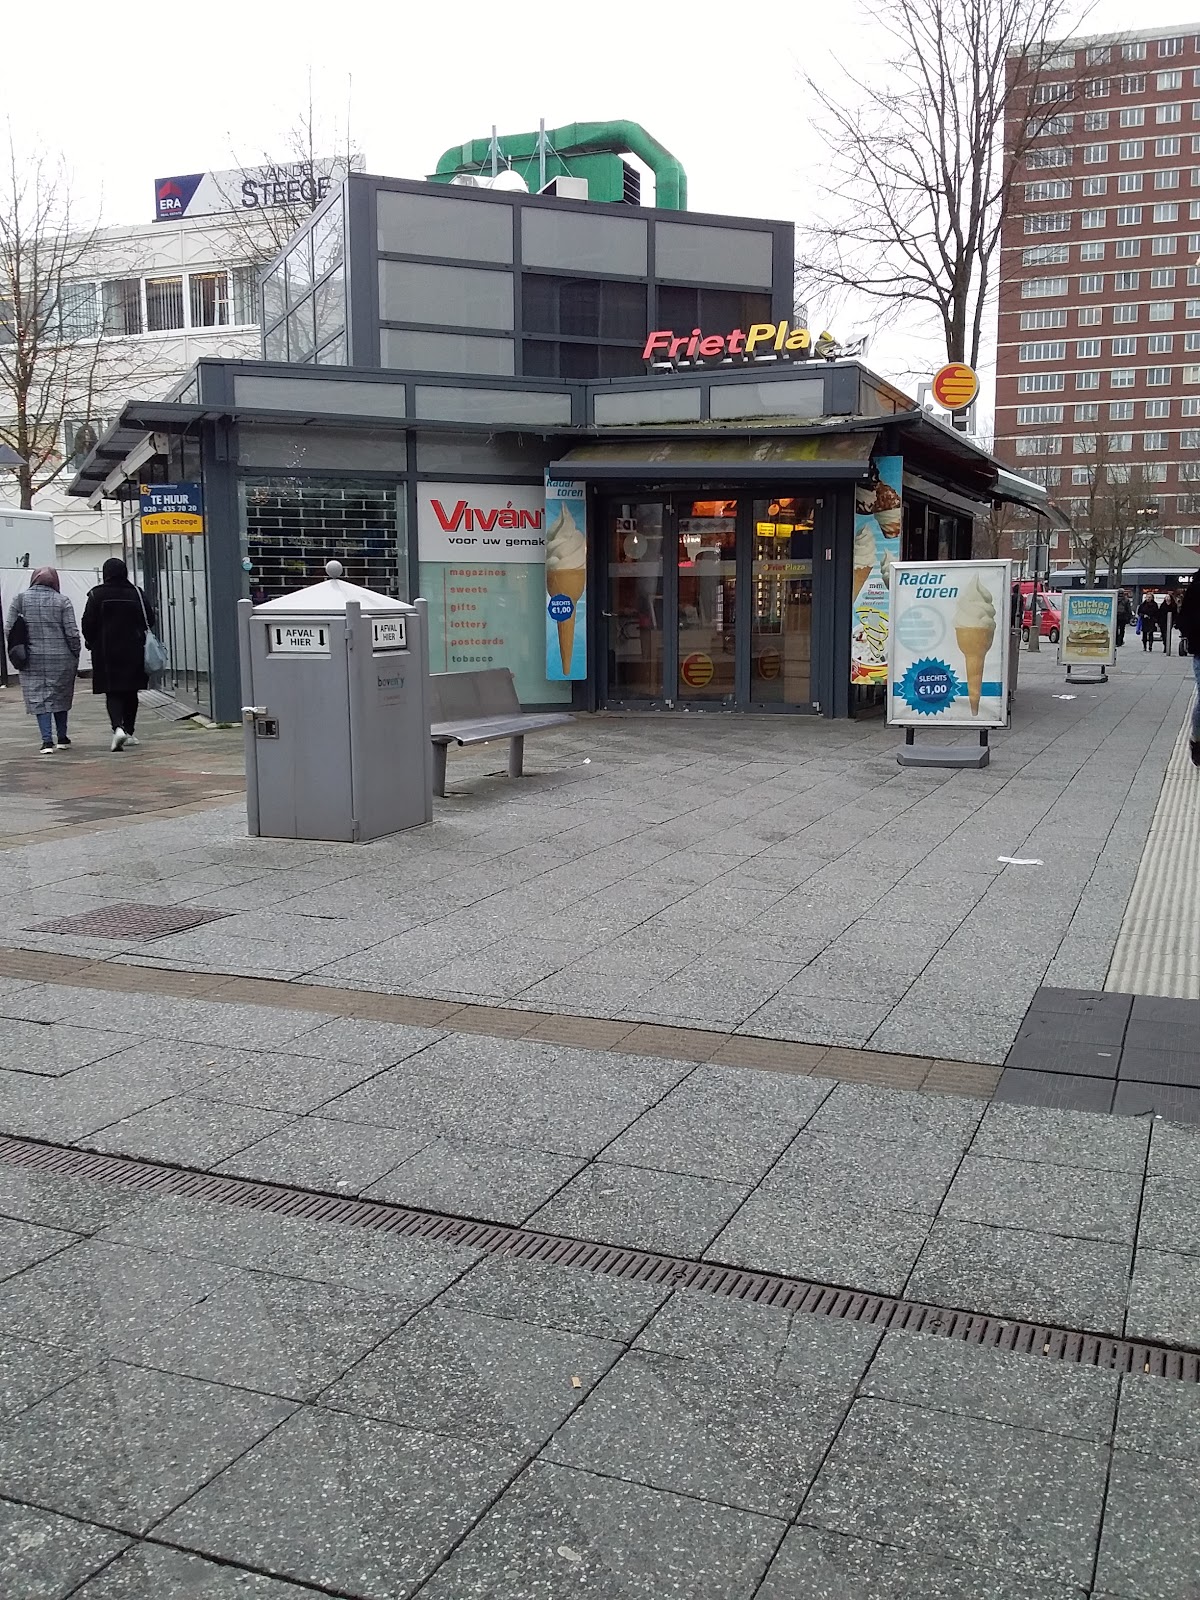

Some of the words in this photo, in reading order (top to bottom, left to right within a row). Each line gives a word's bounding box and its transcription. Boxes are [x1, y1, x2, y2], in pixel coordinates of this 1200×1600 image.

[241, 177, 332, 208] STEEGE
[159, 198, 182, 210] ERA
[642, 320, 868, 359] FrietPla
[557, 488, 584, 497] toren
[151, 494, 162, 505] TE
[163, 494, 189, 505] HUUR
[143, 505, 157, 513] 020
[172, 518, 198, 526] Steege
[448, 537, 478, 545] voor
[505, 537, 545, 547] gemak
[450, 568, 507, 577] magazines
[898, 572, 947, 586] Radar
[450, 585, 488, 594] sweets
[915, 586, 959, 599] toren
[450, 603, 477, 613] gifts
[552, 606, 572, 614] €1,00
[380, 624, 398, 633] AFVAL
[450, 620, 488, 629] lottery
[286, 629, 315, 638] AFVAL
[382, 633, 396, 642] HIER
[290, 638, 312, 646] HIER
[451, 637, 505, 647] postcards
[452, 655, 494, 663] tobacco
[918, 674, 948, 683] SLECHTS
[918, 684, 948, 696] €1,00
